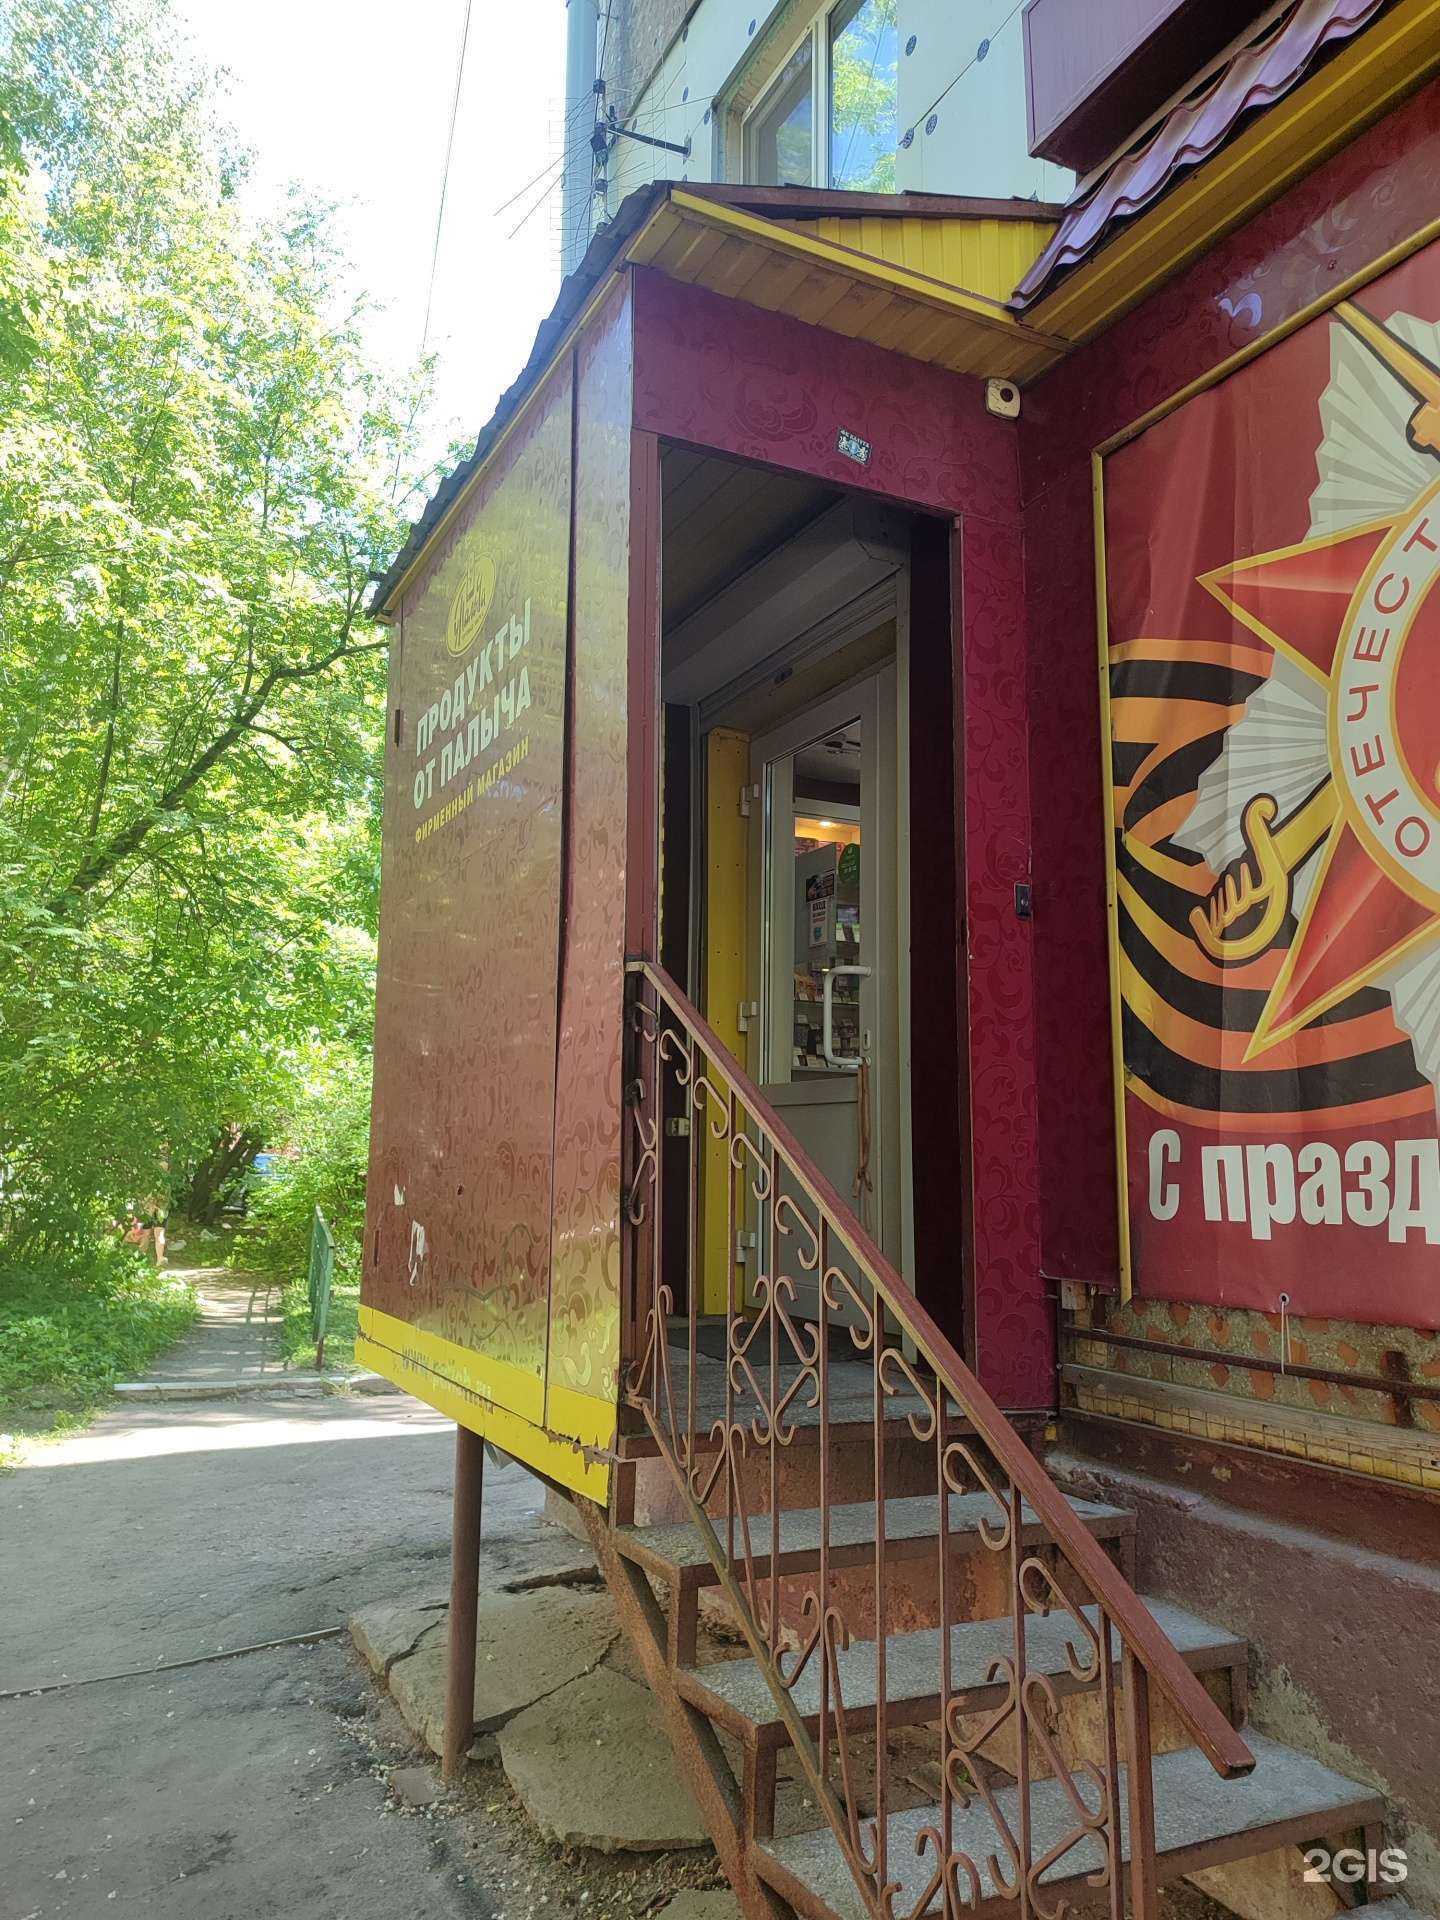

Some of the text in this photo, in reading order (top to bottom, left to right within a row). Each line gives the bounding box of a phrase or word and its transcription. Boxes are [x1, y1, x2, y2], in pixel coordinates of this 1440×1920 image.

[413, 664, 532, 810] ОТ ПАЛЫЧА
[416, 597, 531, 757] ПРОДУКТЫ
[415, 735, 529, 845] ФИРМЕННЫЙ МАГАЗИН
[1201, 1138, 1440, 1245] празд
